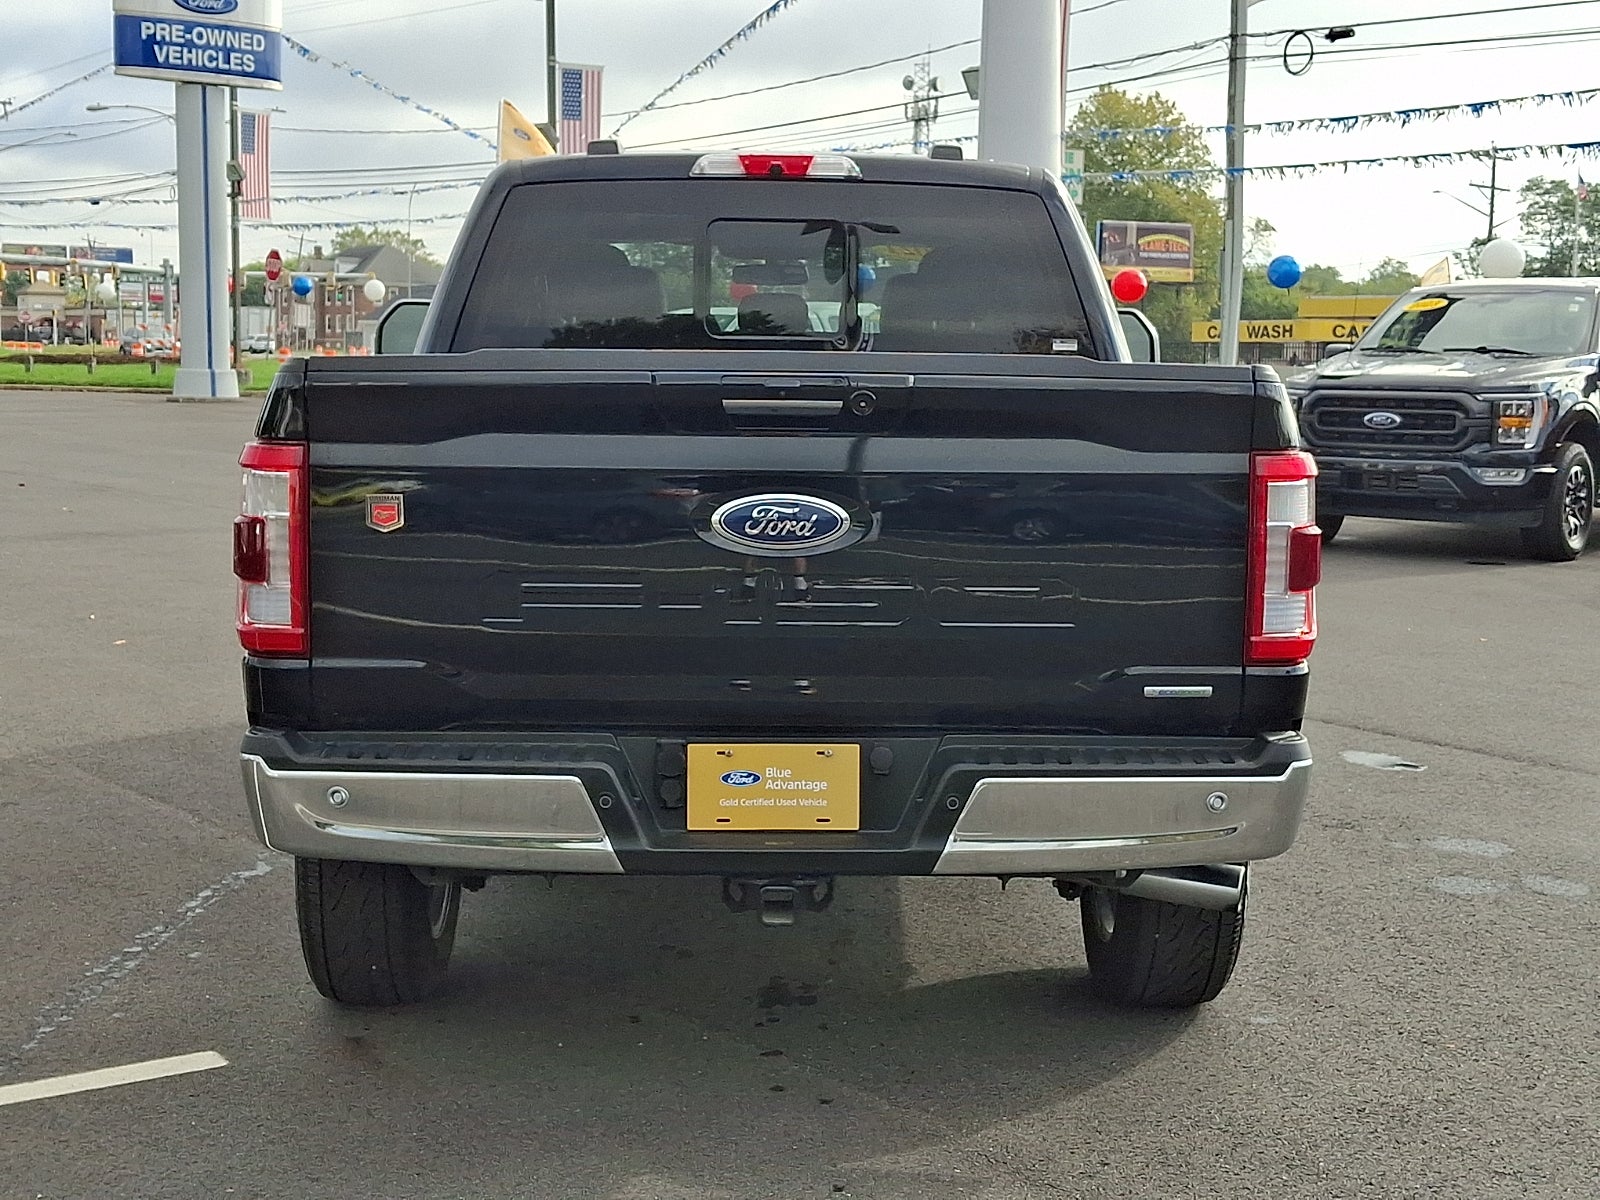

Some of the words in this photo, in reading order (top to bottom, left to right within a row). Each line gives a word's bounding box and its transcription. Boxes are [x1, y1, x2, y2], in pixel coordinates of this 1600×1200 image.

[140, 21, 265, 51] PRE-OWNED
[153, 44, 255, 72] VEHICLES
[1246, 324, 1294, 339] WASH
[744, 505, 818, 536] Ford
[727, 772, 755, 784] Ford
[765, 767, 792, 778] Blue
[765, 779, 828, 792] Advantage
[719, 798, 739, 807] Gold
[740, 798, 775, 807] Certified
[776, 798, 798, 807] Used
[798, 798, 828, 807] Vehicle
